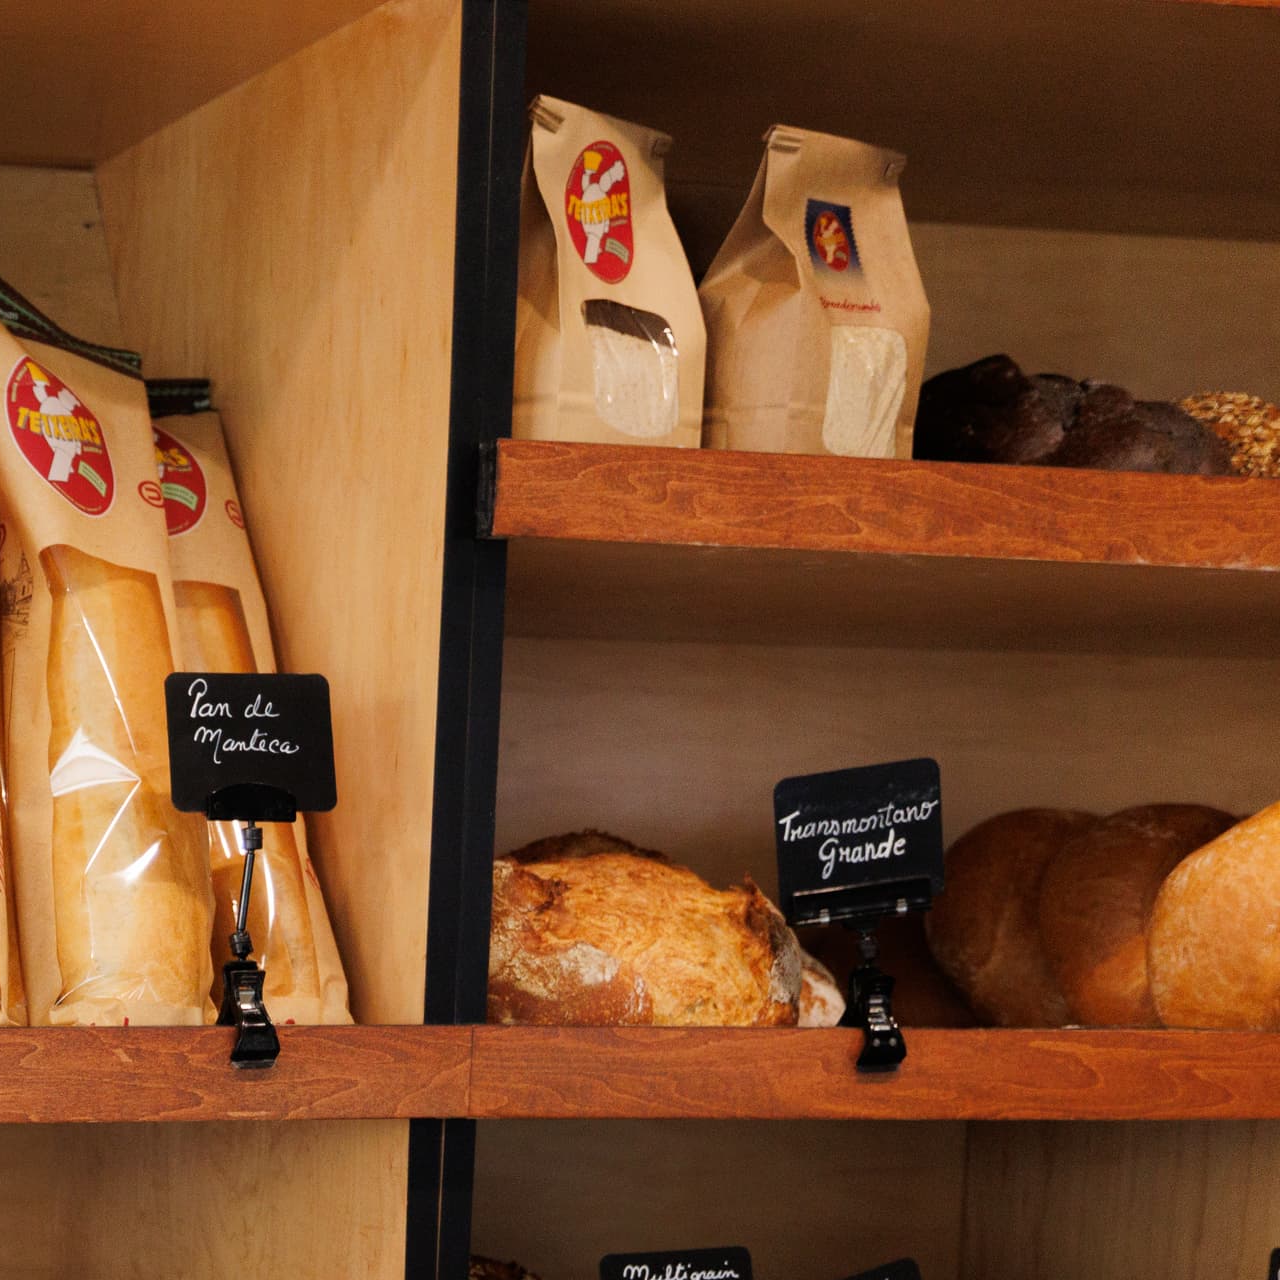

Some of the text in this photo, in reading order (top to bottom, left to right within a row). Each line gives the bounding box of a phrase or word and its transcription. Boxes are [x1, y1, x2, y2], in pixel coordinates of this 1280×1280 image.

[16, 406, 103, 446] TEIXEIRA'S
[186, 678, 281, 719] Pan de
[192, 725, 301, 765] Manteca
[777, 796, 940, 843] Transmontano
[816, 833, 907, 880] Grande
